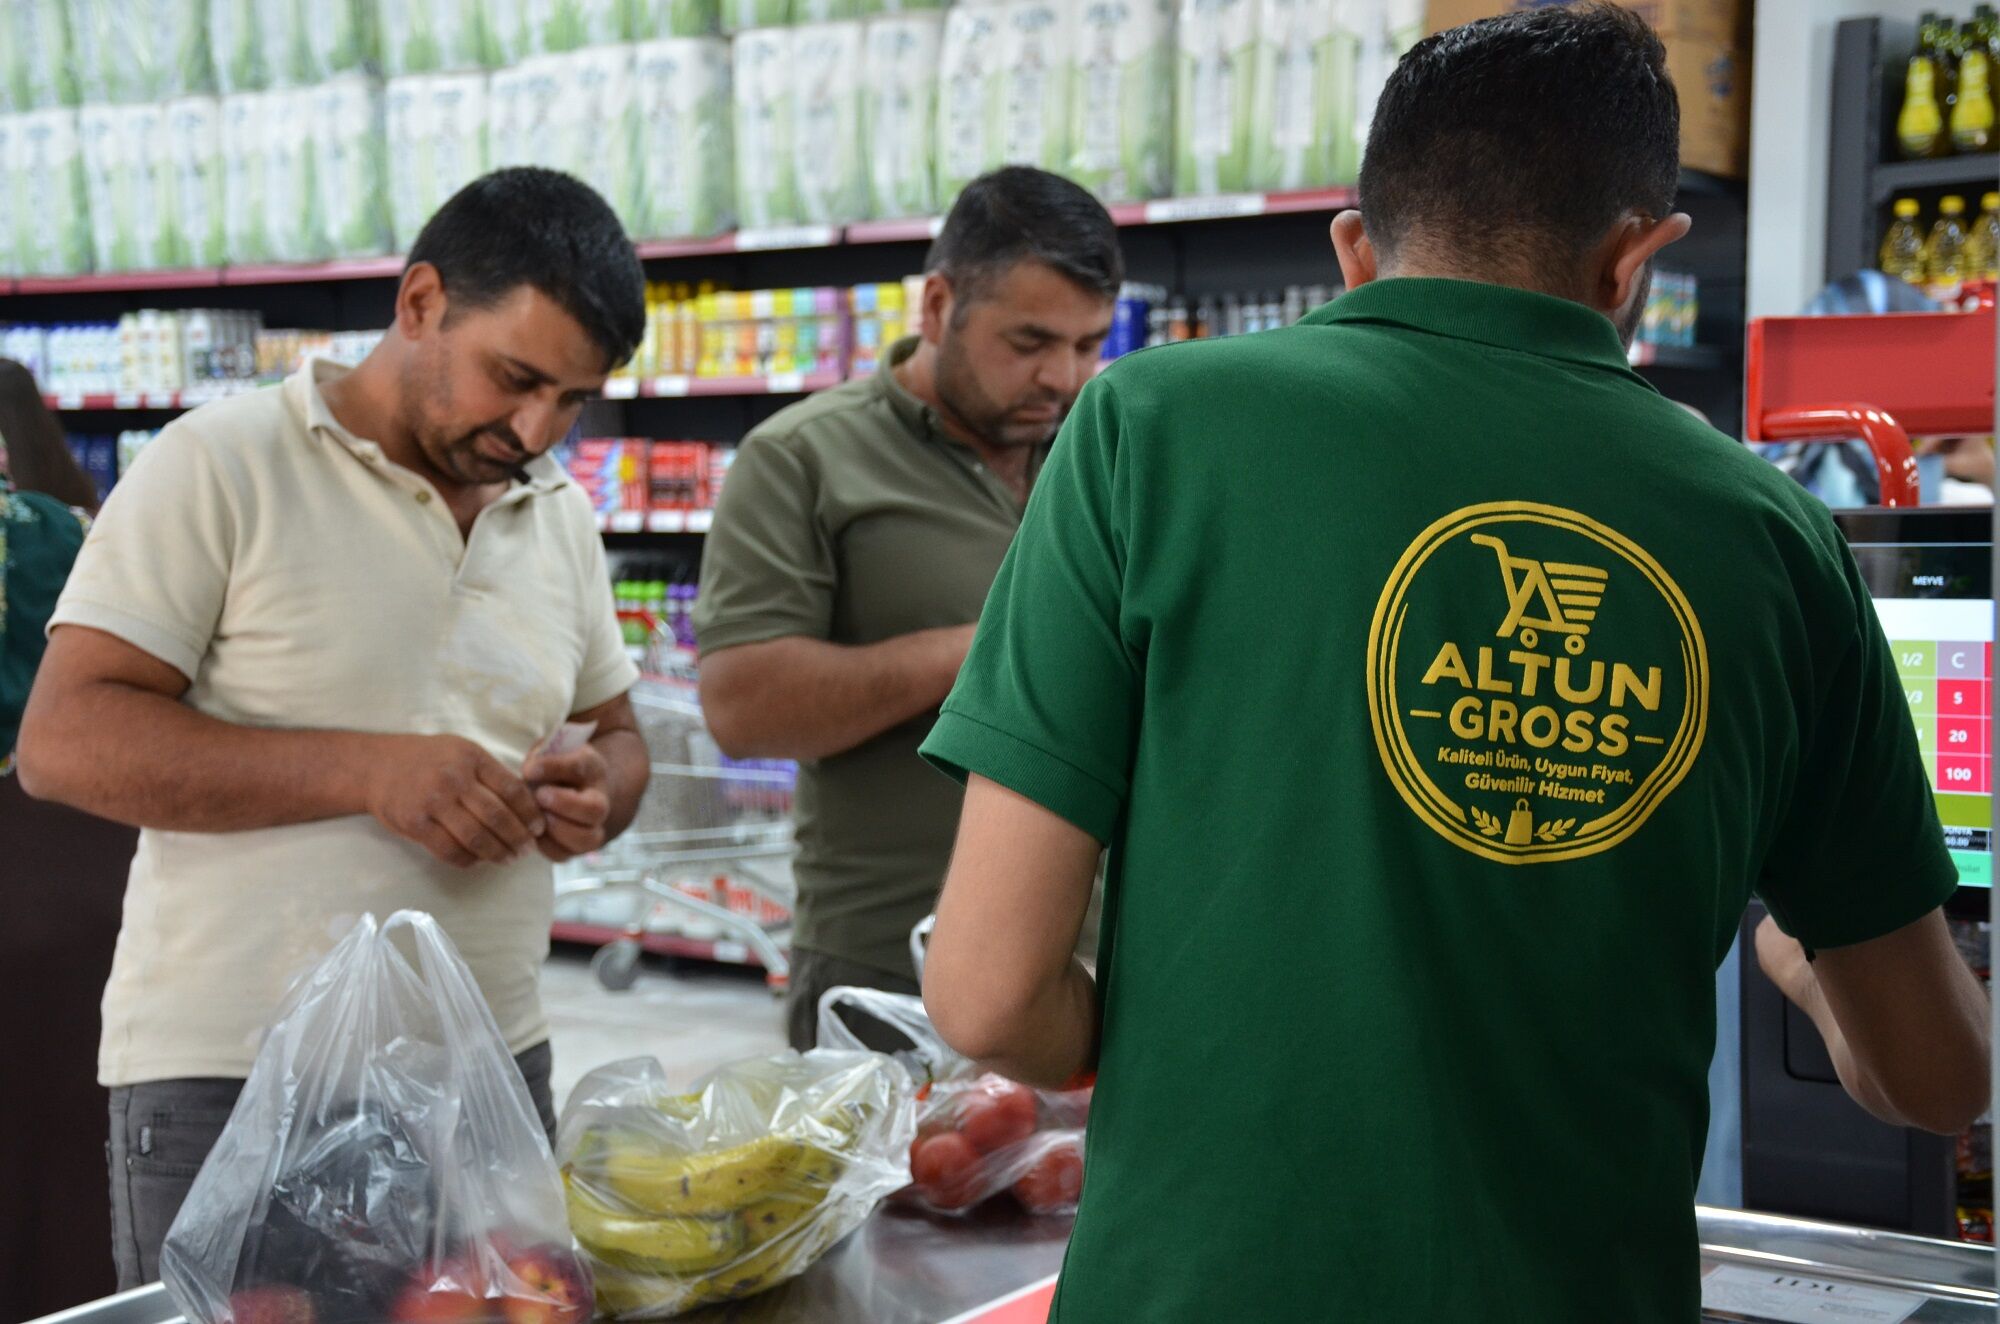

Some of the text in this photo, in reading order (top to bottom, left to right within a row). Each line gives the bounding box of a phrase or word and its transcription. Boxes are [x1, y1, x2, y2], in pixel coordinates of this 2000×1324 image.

[1912, 575, 1944, 586] MEYVE
[1902, 652, 1924, 668] 1/2
[1951, 652, 1966, 669] C
[1421, 642, 1662, 711] ALTUN
[1953, 691, 1964, 705] 5
[1449, 696, 1630, 757] GROSS
[1948, 729, 1968, 743] 20
[1437, 746, 1634, 785] Kaliteli Ürün, Uygun Fiyat,
[1945, 767, 1972, 781] 100
[1464, 772, 1605, 804] Güvenilir Hizmet
